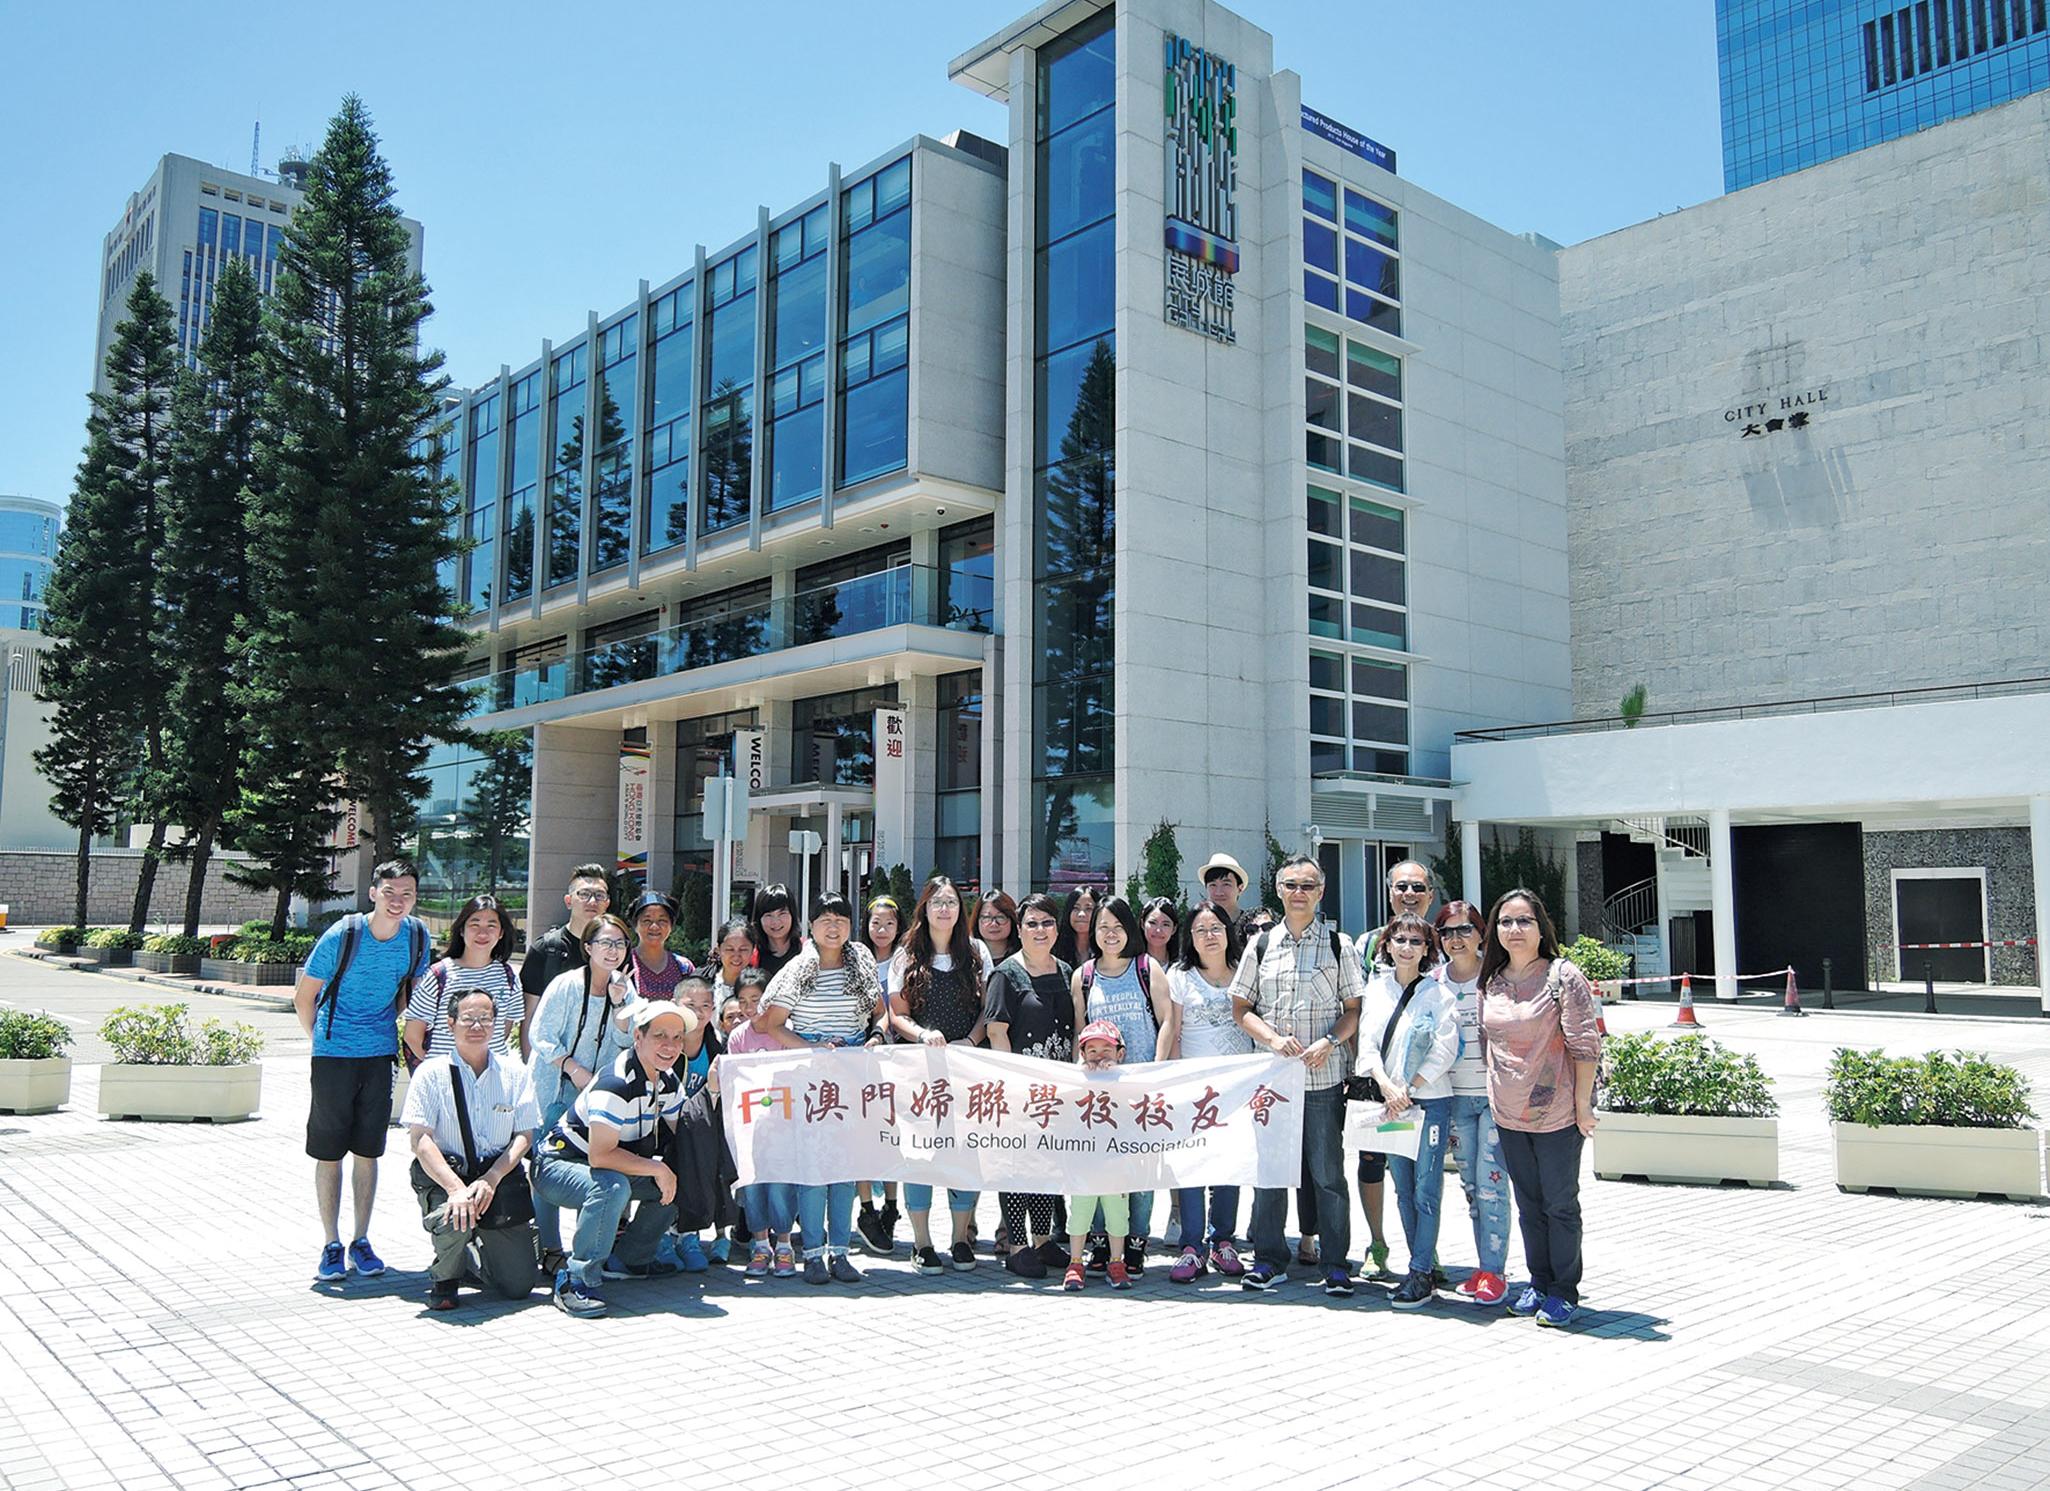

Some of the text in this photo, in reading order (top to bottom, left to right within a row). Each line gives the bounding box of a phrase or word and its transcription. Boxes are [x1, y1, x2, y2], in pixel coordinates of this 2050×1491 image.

[1320, 118, 1342, 137] Products
[1343, 131, 1359, 146] House
[1376, 147, 1386, 159] Year
[1168, 254, 1235, 312] 展城館
[1724, 389, 1828, 423] CITY HALL
[886, 715, 903, 758] 歡迎
[750, 736, 762, 790] WELCO
[628, 783, 636, 811] HONG
[804, 1078, 1291, 1135] 澳門婦聯學校校友會
[880, 1131, 1207, 1154] Fu Luen School Alumni Association
